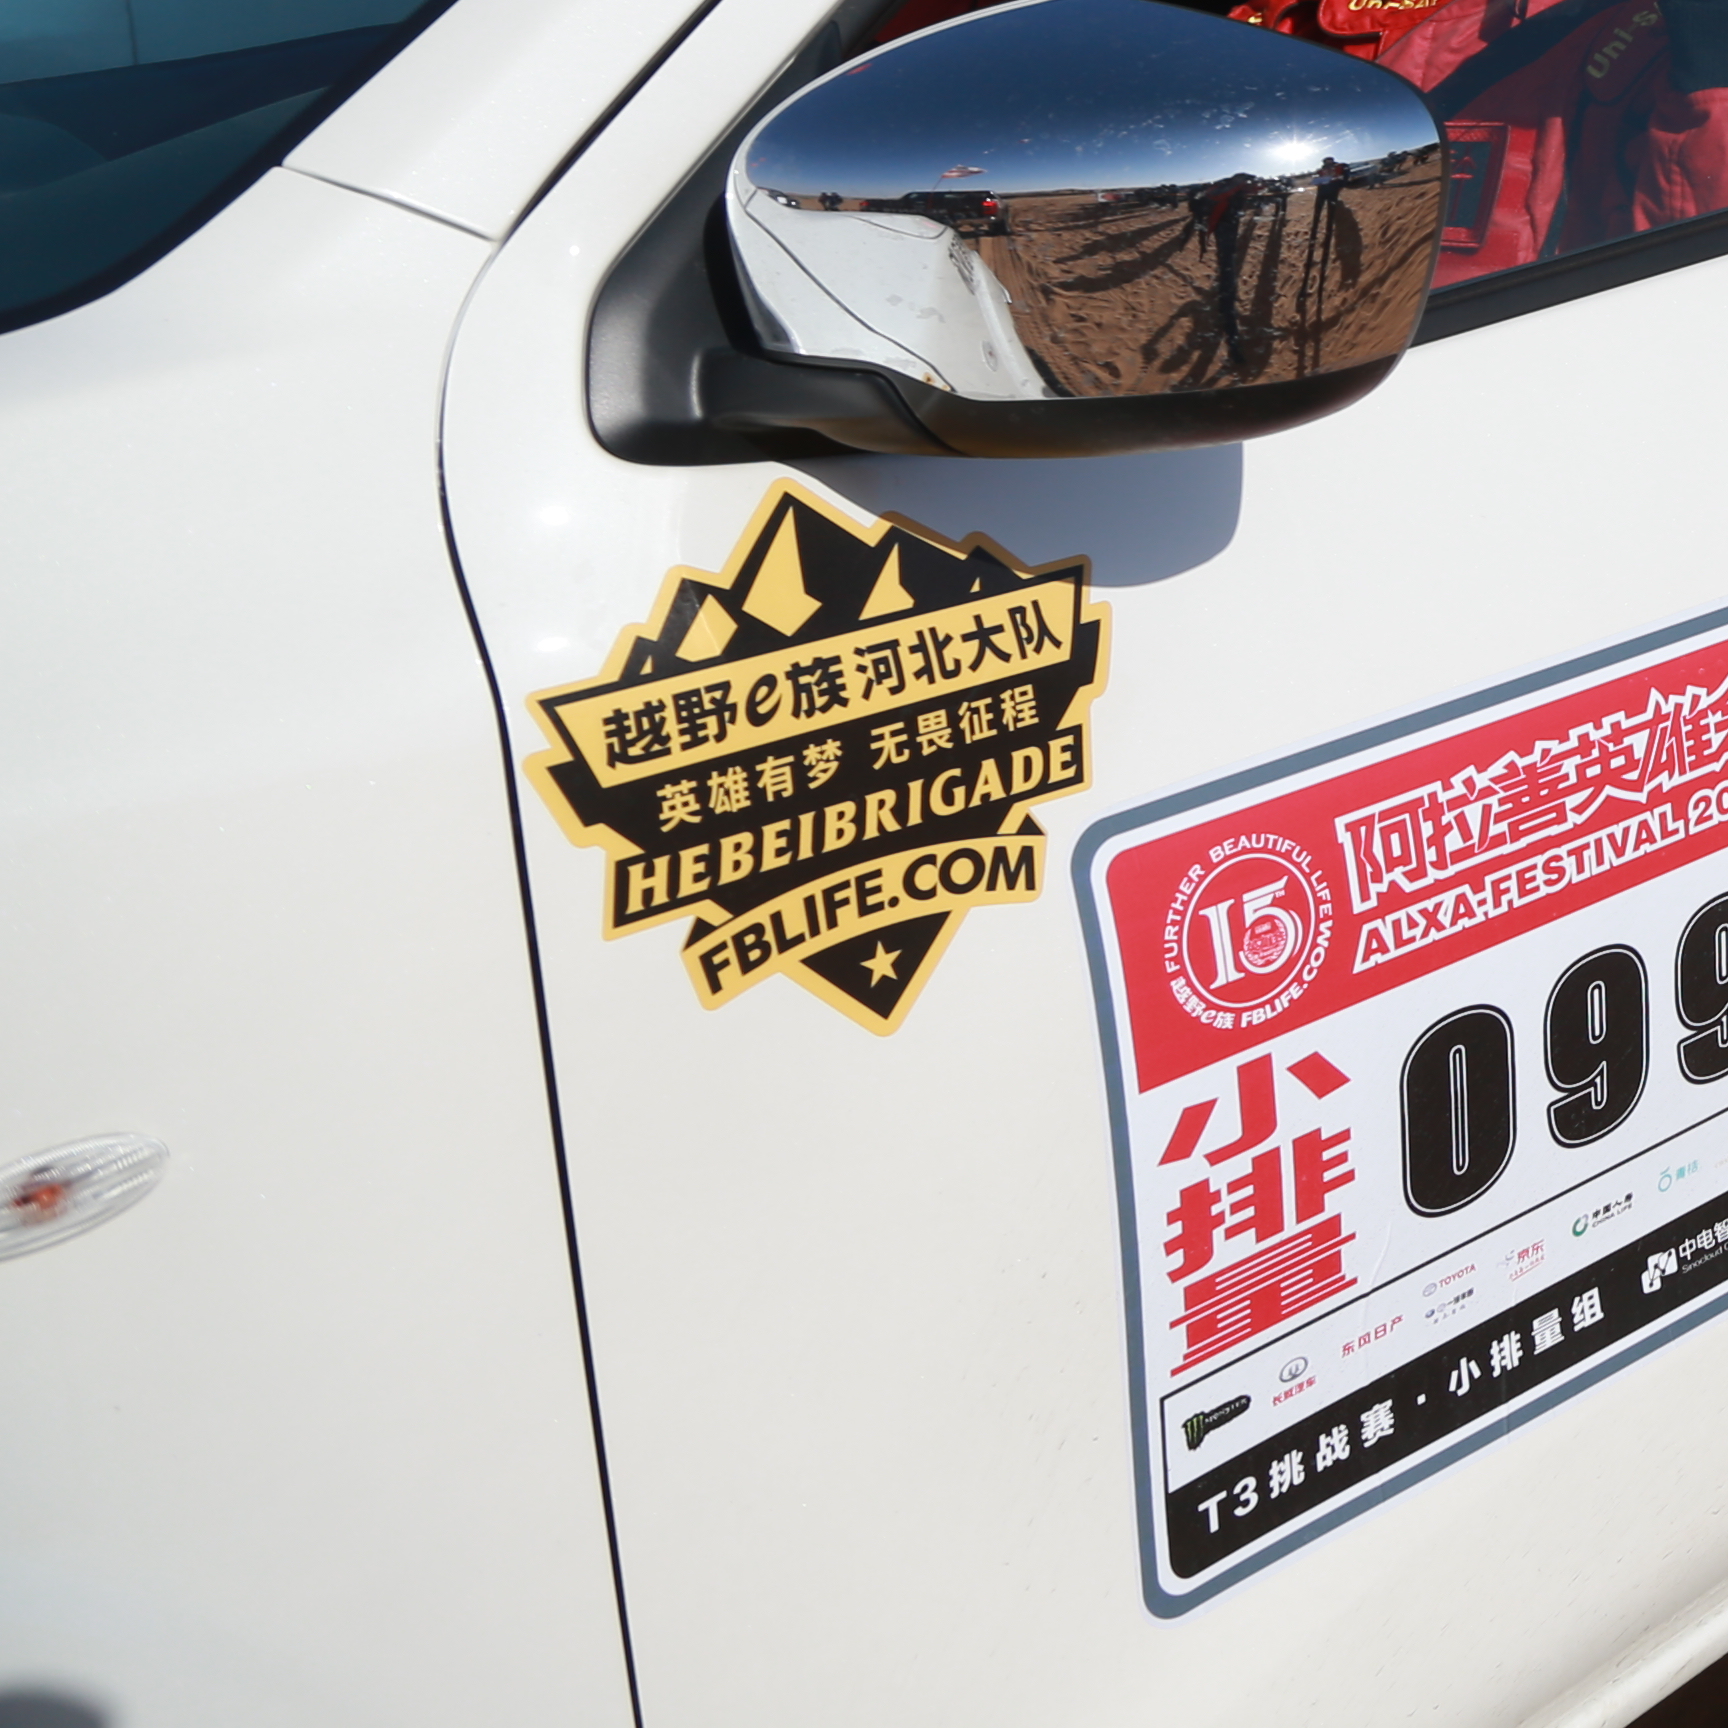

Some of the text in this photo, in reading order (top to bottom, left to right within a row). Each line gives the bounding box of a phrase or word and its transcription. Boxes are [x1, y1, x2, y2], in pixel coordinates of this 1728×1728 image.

[601, 599, 1063, 770] 越野e族河北大队
[656, 684, 1040, 832] 英雄有梦 无畏征程
[624, 735, 1077, 915] HEBEIBRIGADE
[1353, 805, 1685, 974] ALXA-FESTIVAL
[698, 845, 1036, 995] FBLIFE.COM
[1164, 864, 1206, 973] FURTHER
[1208, 833, 1312, 873] BEAUTIFUL
[1310, 870, 1333, 918] LIFE
[1240, 920, 1333, 1028] FBLIFE.COM
[1158, 1051, 1359, 1378] 小排量
[1439, 1264, 1476, 1288] TOYOTA
[1682, 1246, 1723, 1274] Sinocloud
[1341, 1315, 1403, 1358] 东风日产
